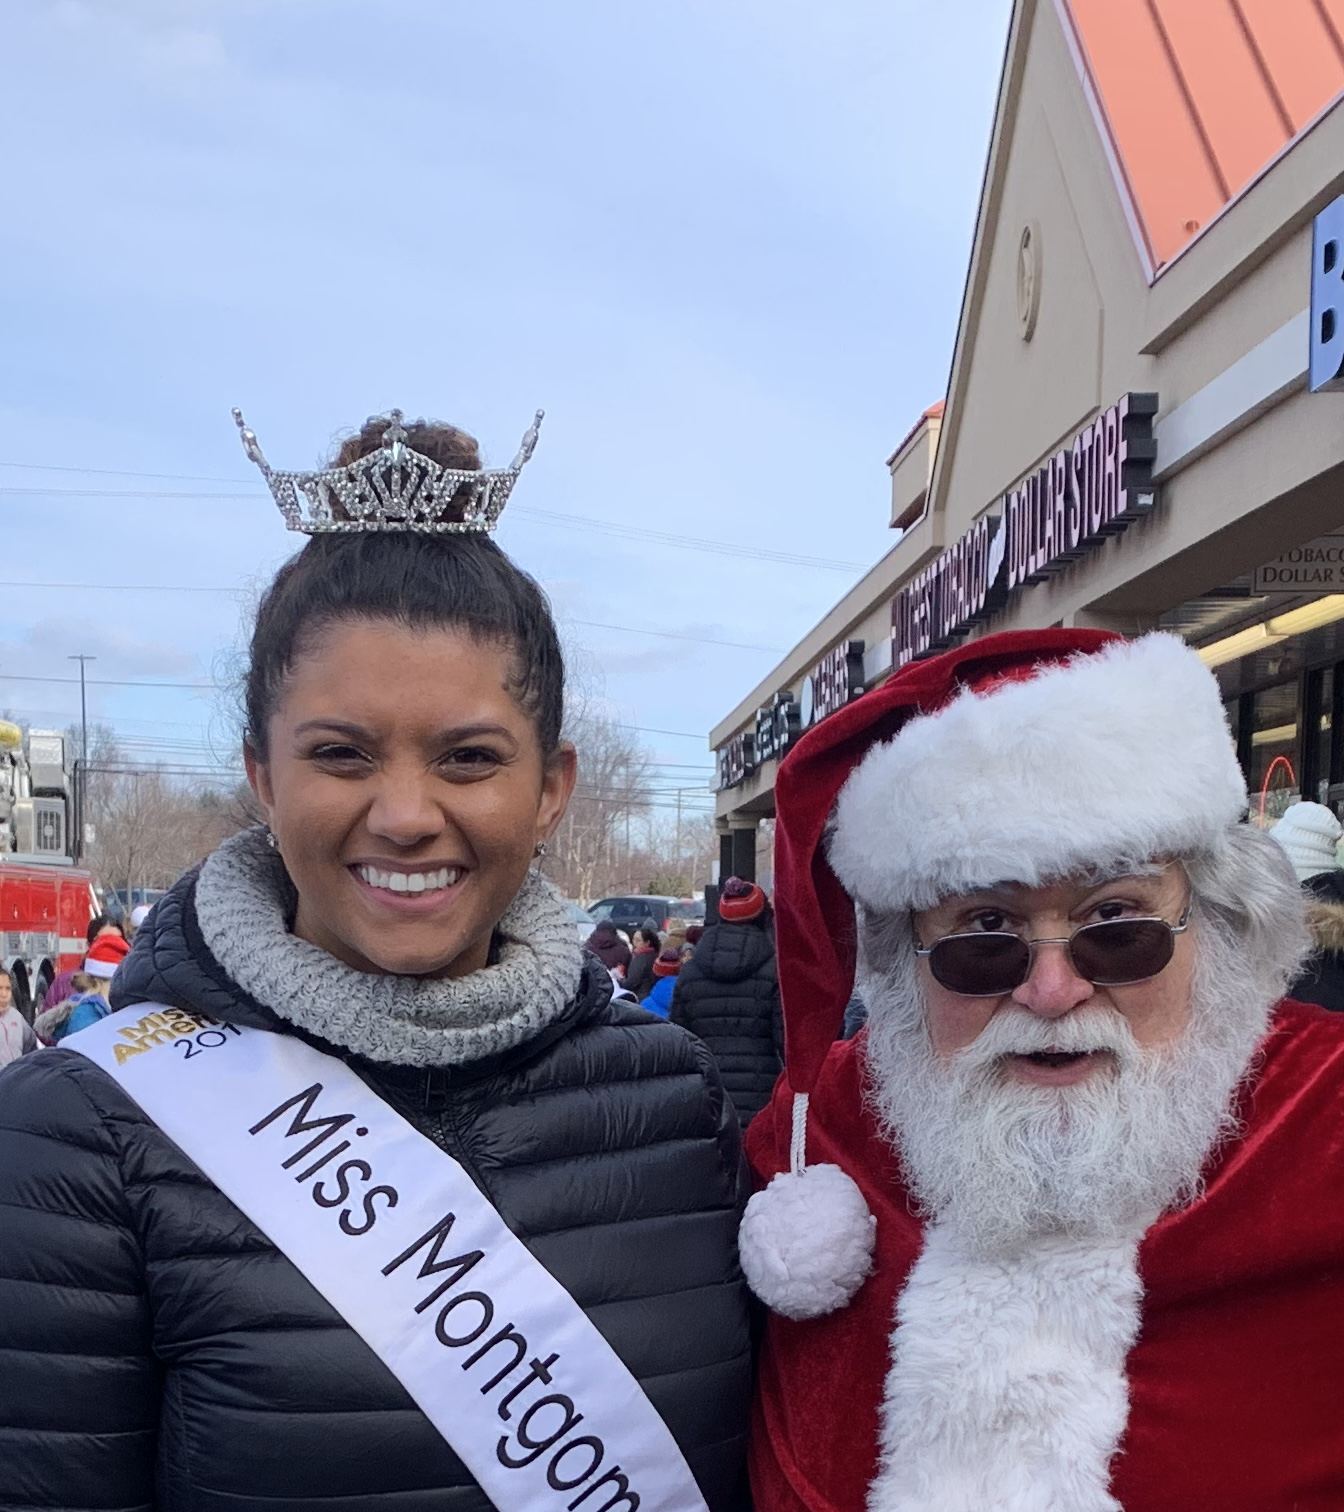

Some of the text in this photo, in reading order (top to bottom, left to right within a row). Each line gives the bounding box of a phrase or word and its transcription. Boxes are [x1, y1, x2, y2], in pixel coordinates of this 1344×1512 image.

[1008, 449, 1066, 590] DOLLAR
[1070, 392, 1130, 548] STORE
[1262, 566, 1334, 583] DOLLAR
[246, 1081, 399, 1238] Miss
